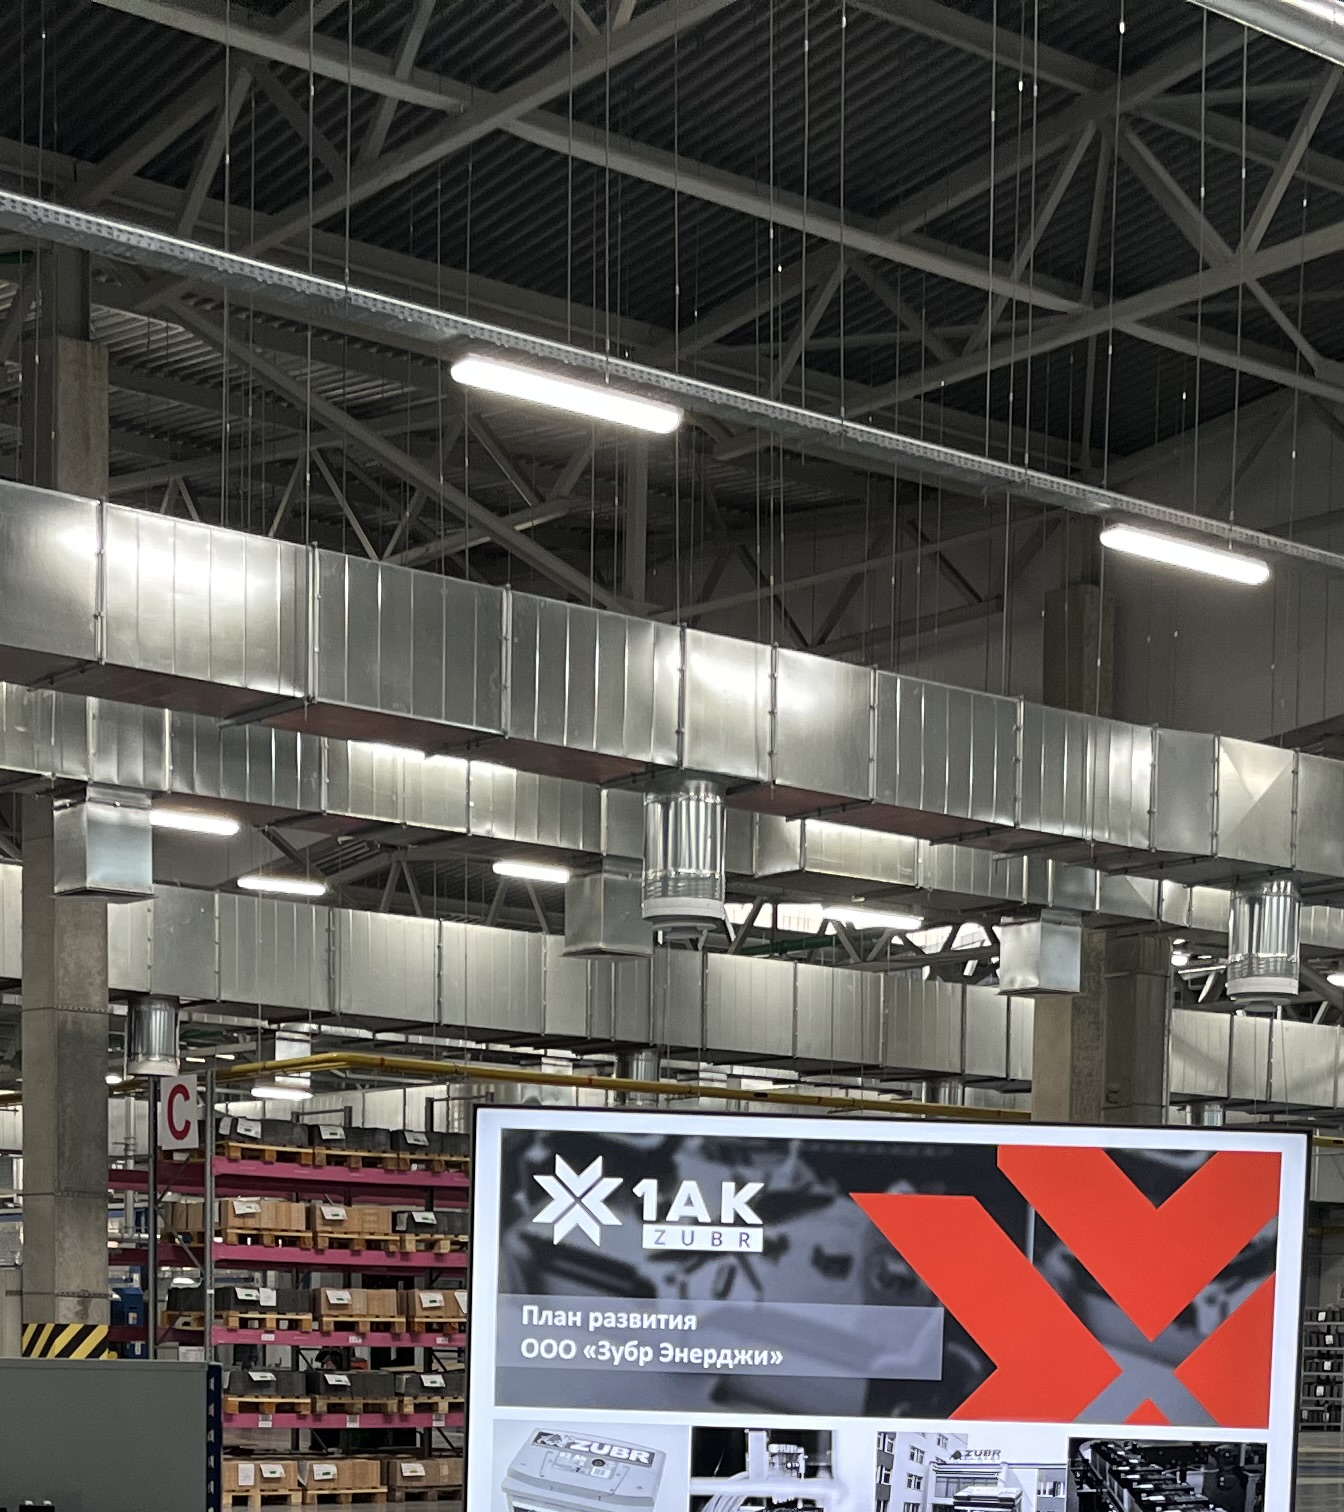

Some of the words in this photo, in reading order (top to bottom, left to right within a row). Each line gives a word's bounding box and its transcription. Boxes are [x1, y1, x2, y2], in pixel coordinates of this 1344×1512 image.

[167, 1084, 192, 1140] C
[632, 1178, 765, 1225] 1AK
[653, 1229, 752, 1248] ZUBR
[522, 1305, 582, 1327] План
[588, 1311, 698, 1332] развития
[520, 1338, 577, 1360] ООО
[582, 1340, 654, 1367] «Зубр
[658, 1342, 784, 1369] Энерджи»
[569, 1439, 651, 1465] ZUBR
[964, 1449, 1002, 1457] ZUBR
